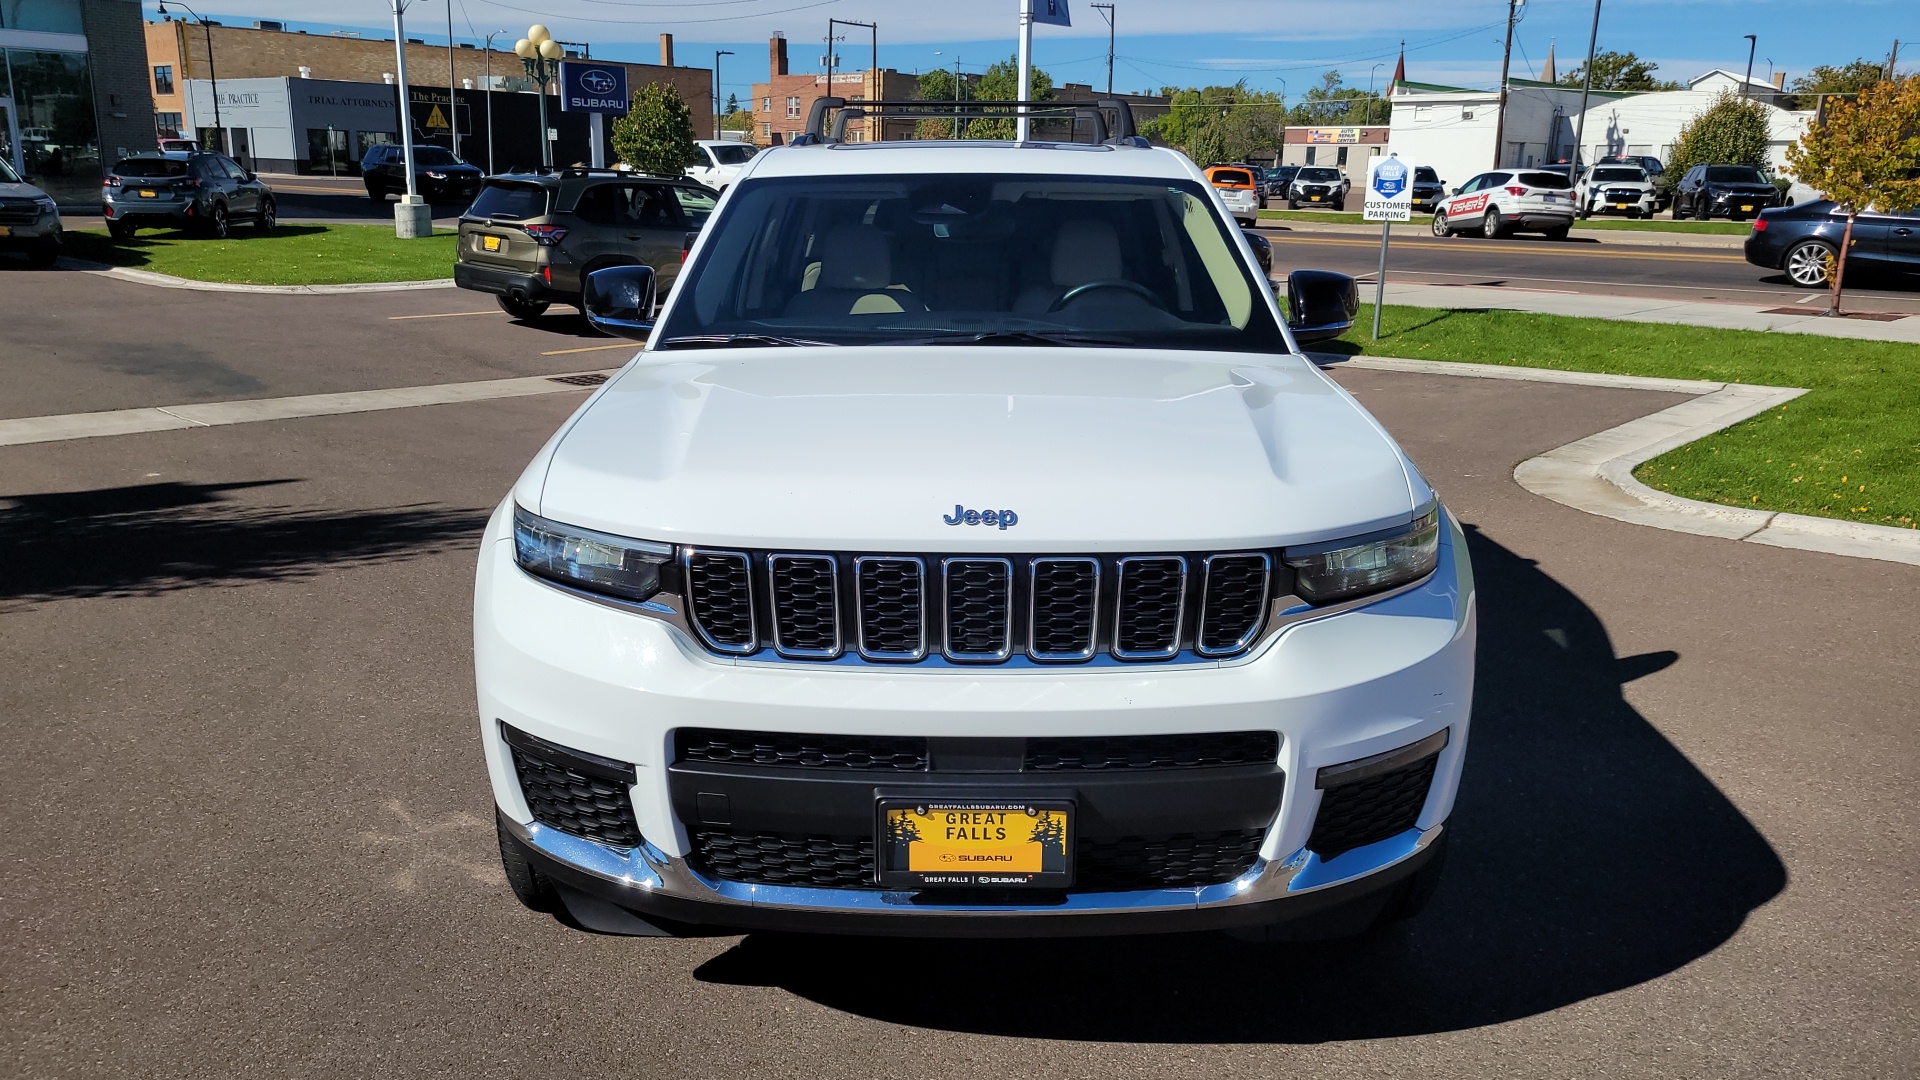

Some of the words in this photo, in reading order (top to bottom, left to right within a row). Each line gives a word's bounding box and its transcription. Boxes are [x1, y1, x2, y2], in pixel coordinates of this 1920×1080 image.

[228, 93, 259, 105] PRACTICE
[307, 95, 338, 105] TRIAL
[340, 97, 395, 108] ATTORNEYS
[412, 91, 429, 101] The
[431, 92, 465, 104] Pracce
[572, 97, 624, 109] SUBARU
[1364, 201, 1411, 210] CUSTOMER
[1368, 210, 1406, 219] PARKING
[943, 504, 1019, 531] Jeep
[945, 812, 1007, 825] GREAT
[946, 827, 1007, 841] FALLS
